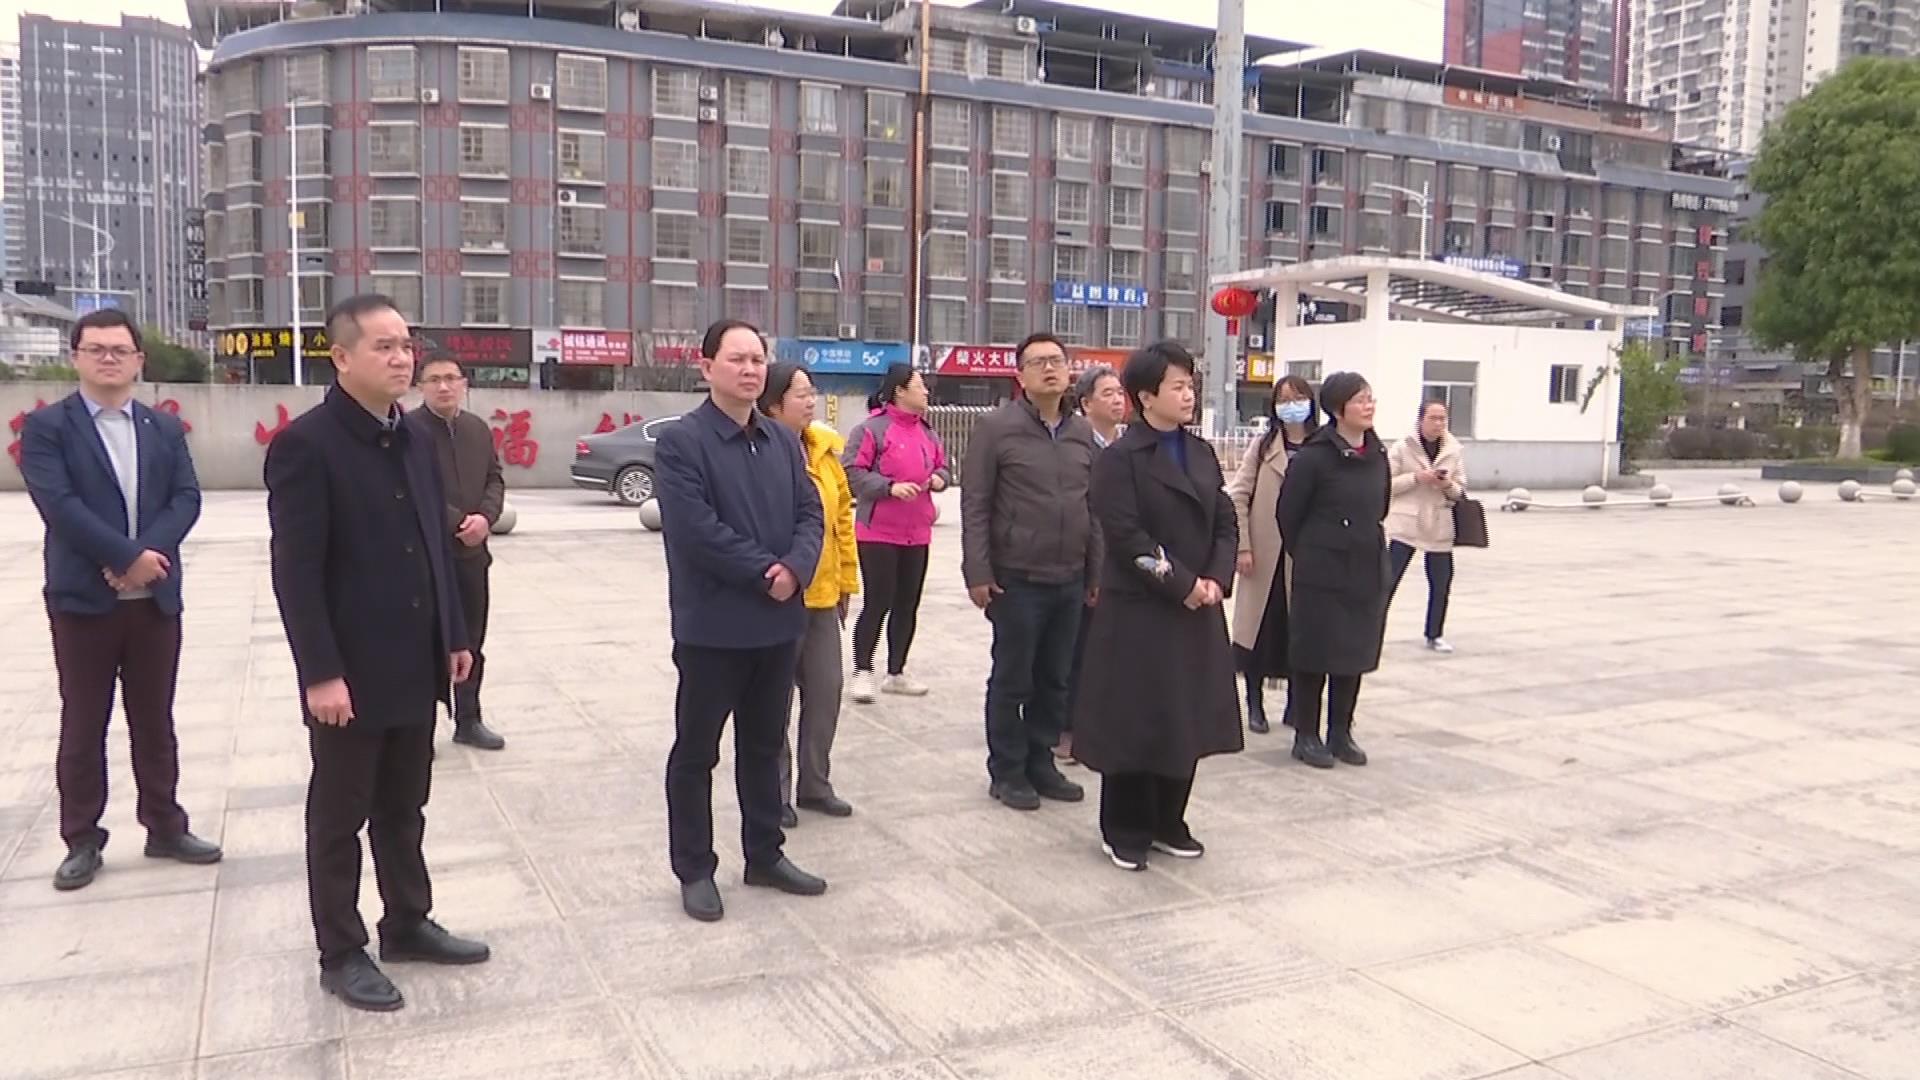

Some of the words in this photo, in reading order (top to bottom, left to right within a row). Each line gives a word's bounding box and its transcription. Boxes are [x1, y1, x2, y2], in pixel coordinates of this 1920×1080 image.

[821, 349, 851, 358] 中国移动
[863, 350, 881, 366] 5G
